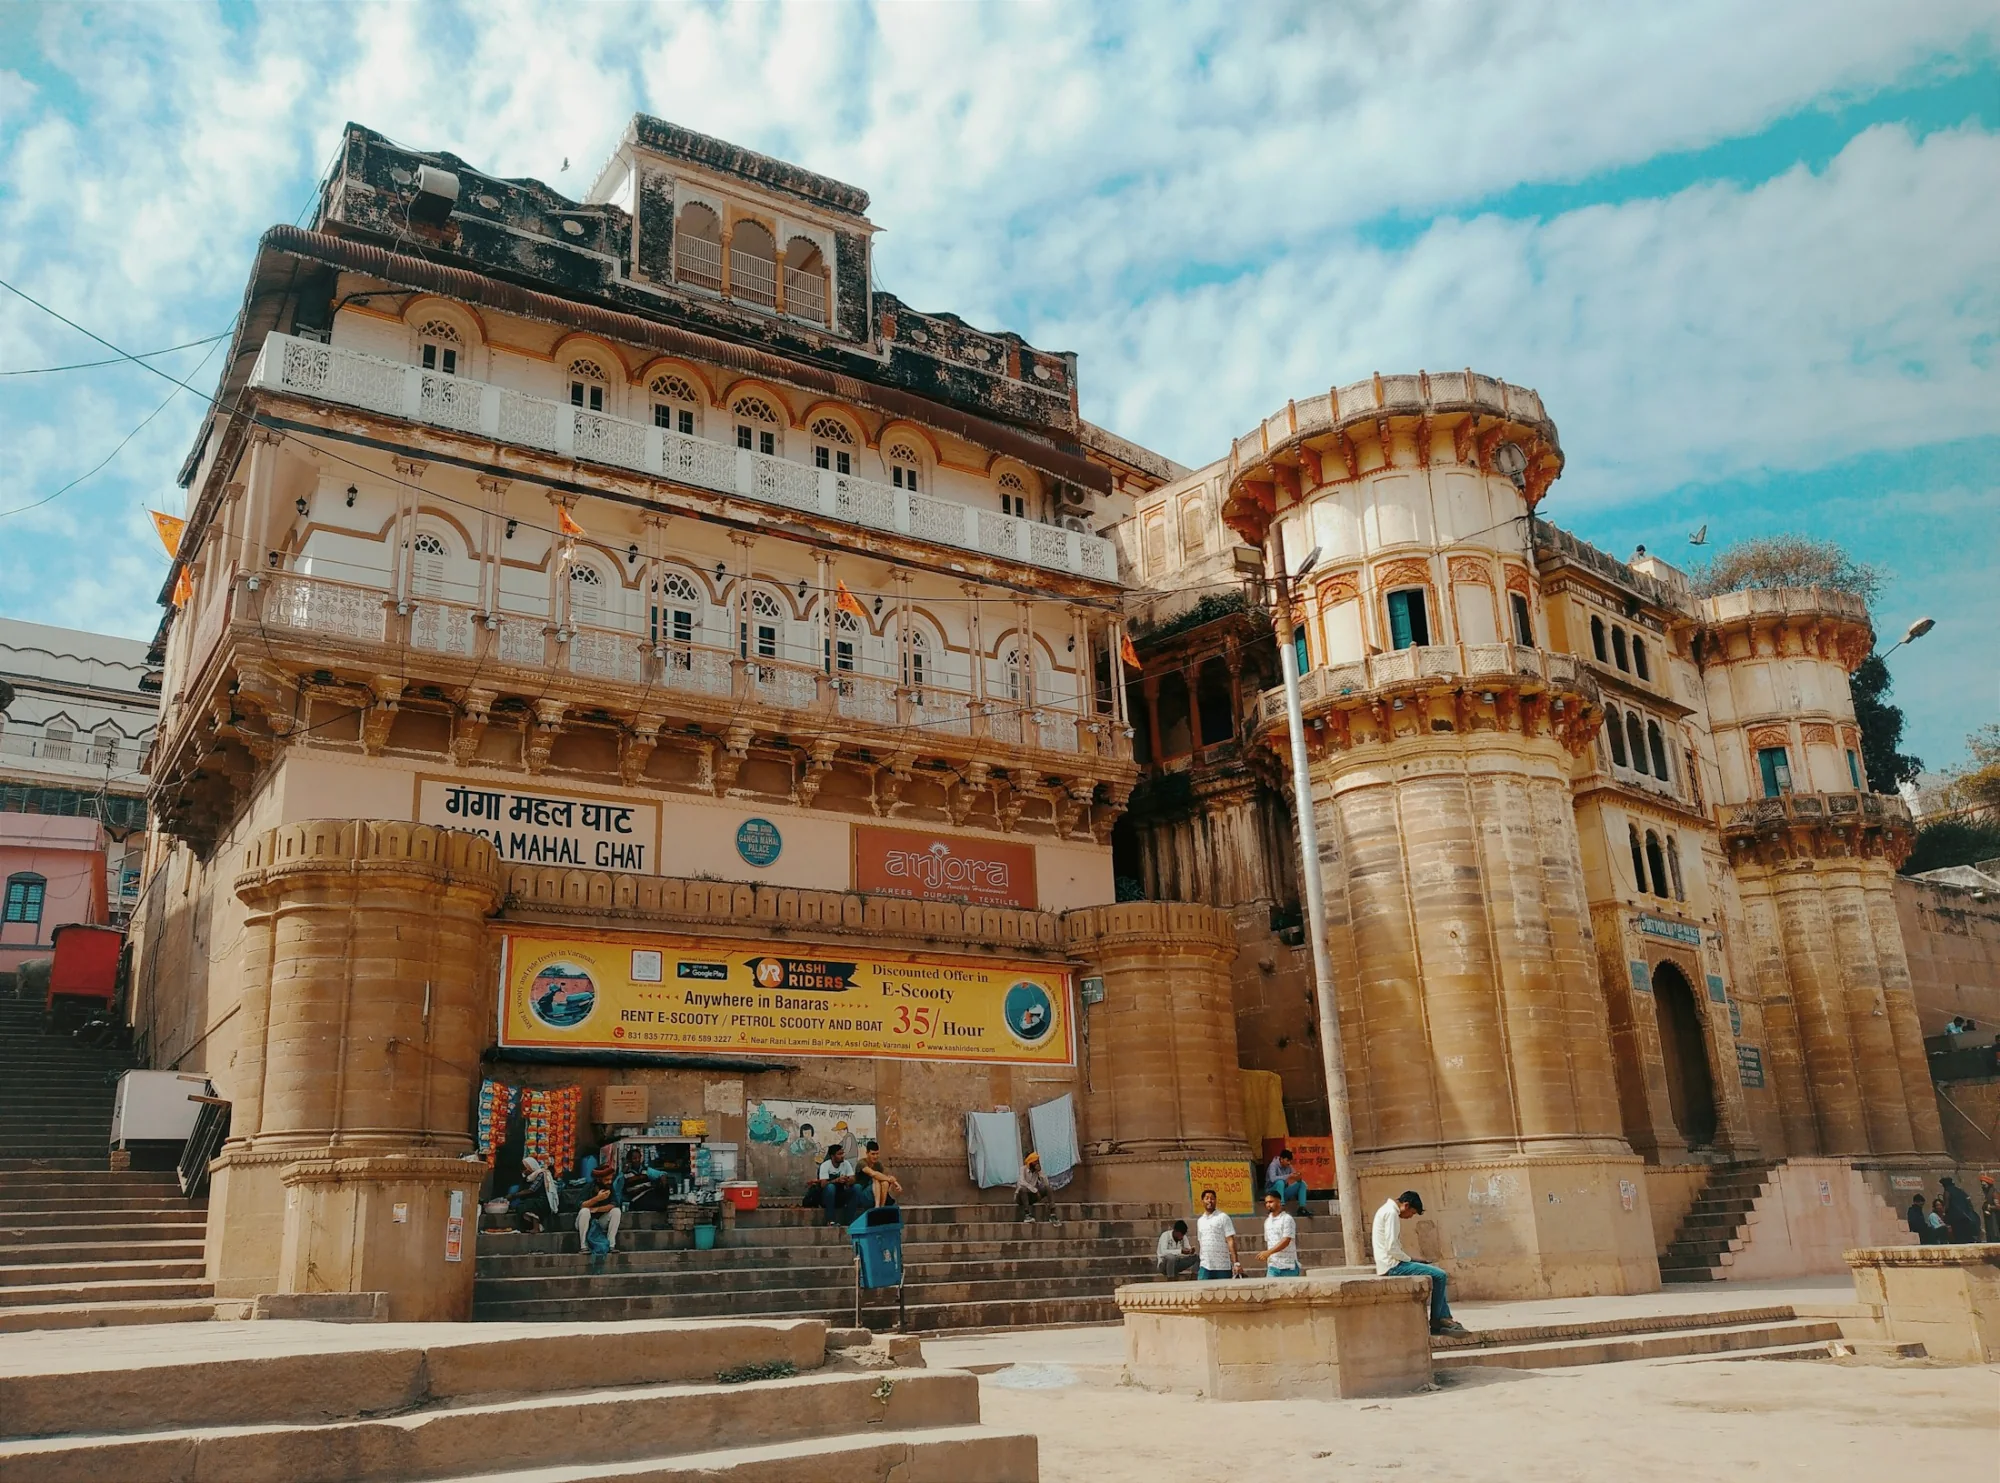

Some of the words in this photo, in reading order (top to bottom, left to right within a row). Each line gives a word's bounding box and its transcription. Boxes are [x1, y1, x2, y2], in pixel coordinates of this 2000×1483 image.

[446, 786, 506, 820] गंगा
[509, 795, 576, 828] महल
[580, 803, 635, 834] घाट
[510, 832, 586, 865] MAHAL
[595, 840, 645, 870] GHAT
[748, 843, 770, 854] PALACE
[884, 848, 1009, 889] anjora
[875, 886, 913, 896] SAREES
[979, 896, 1020, 906] TEXTILES
[520, 971, 529, 985] and
[527, 960, 538, 973] ride
[537, 951, 557, 963] freely
[567, 949, 597, 965] Varanasi
[692, 969, 713, 978] Google
[713, 970, 725, 978] Play
[789, 962, 826, 974] KASHI
[872, 964, 939, 979] Discounted
[943, 969, 974, 982] Offer
[977, 971, 989, 983] in
[789, 976, 844, 989] RIDERS
[685, 990, 753, 1009] Anywhere
[758, 993, 770, 1009] in
[775, 995, 829, 1011] Banaras
[881, 981, 954, 1004] E-Scooty
[621, 1009, 654, 1022] RENT
[658, 1012, 719, 1026] E-SCOOTY
[731, 1015, 775, 1028] PETROL
[780, 1017, 825, 1030] SCOOTY
[828, 1019, 851, 1031] AND
[856, 1020, 883, 1032] BOAT
[943, 1021, 985, 1037] Hour
[644, 1032, 658, 1040] 835
[682, 1034, 696, 1042] 876
[714, 1035, 732, 1043] 3227
[769, 1037, 787, 1045] Rani
[788, 1038, 810, 1046] Laxmi
[812, 1038, 824, 1046] Bai
[825, 1039, 843, 1047] Park,
[883, 1041, 911, 1049] Varanasi
[927, 1044, 996, 1053] www.kashiriders.com
